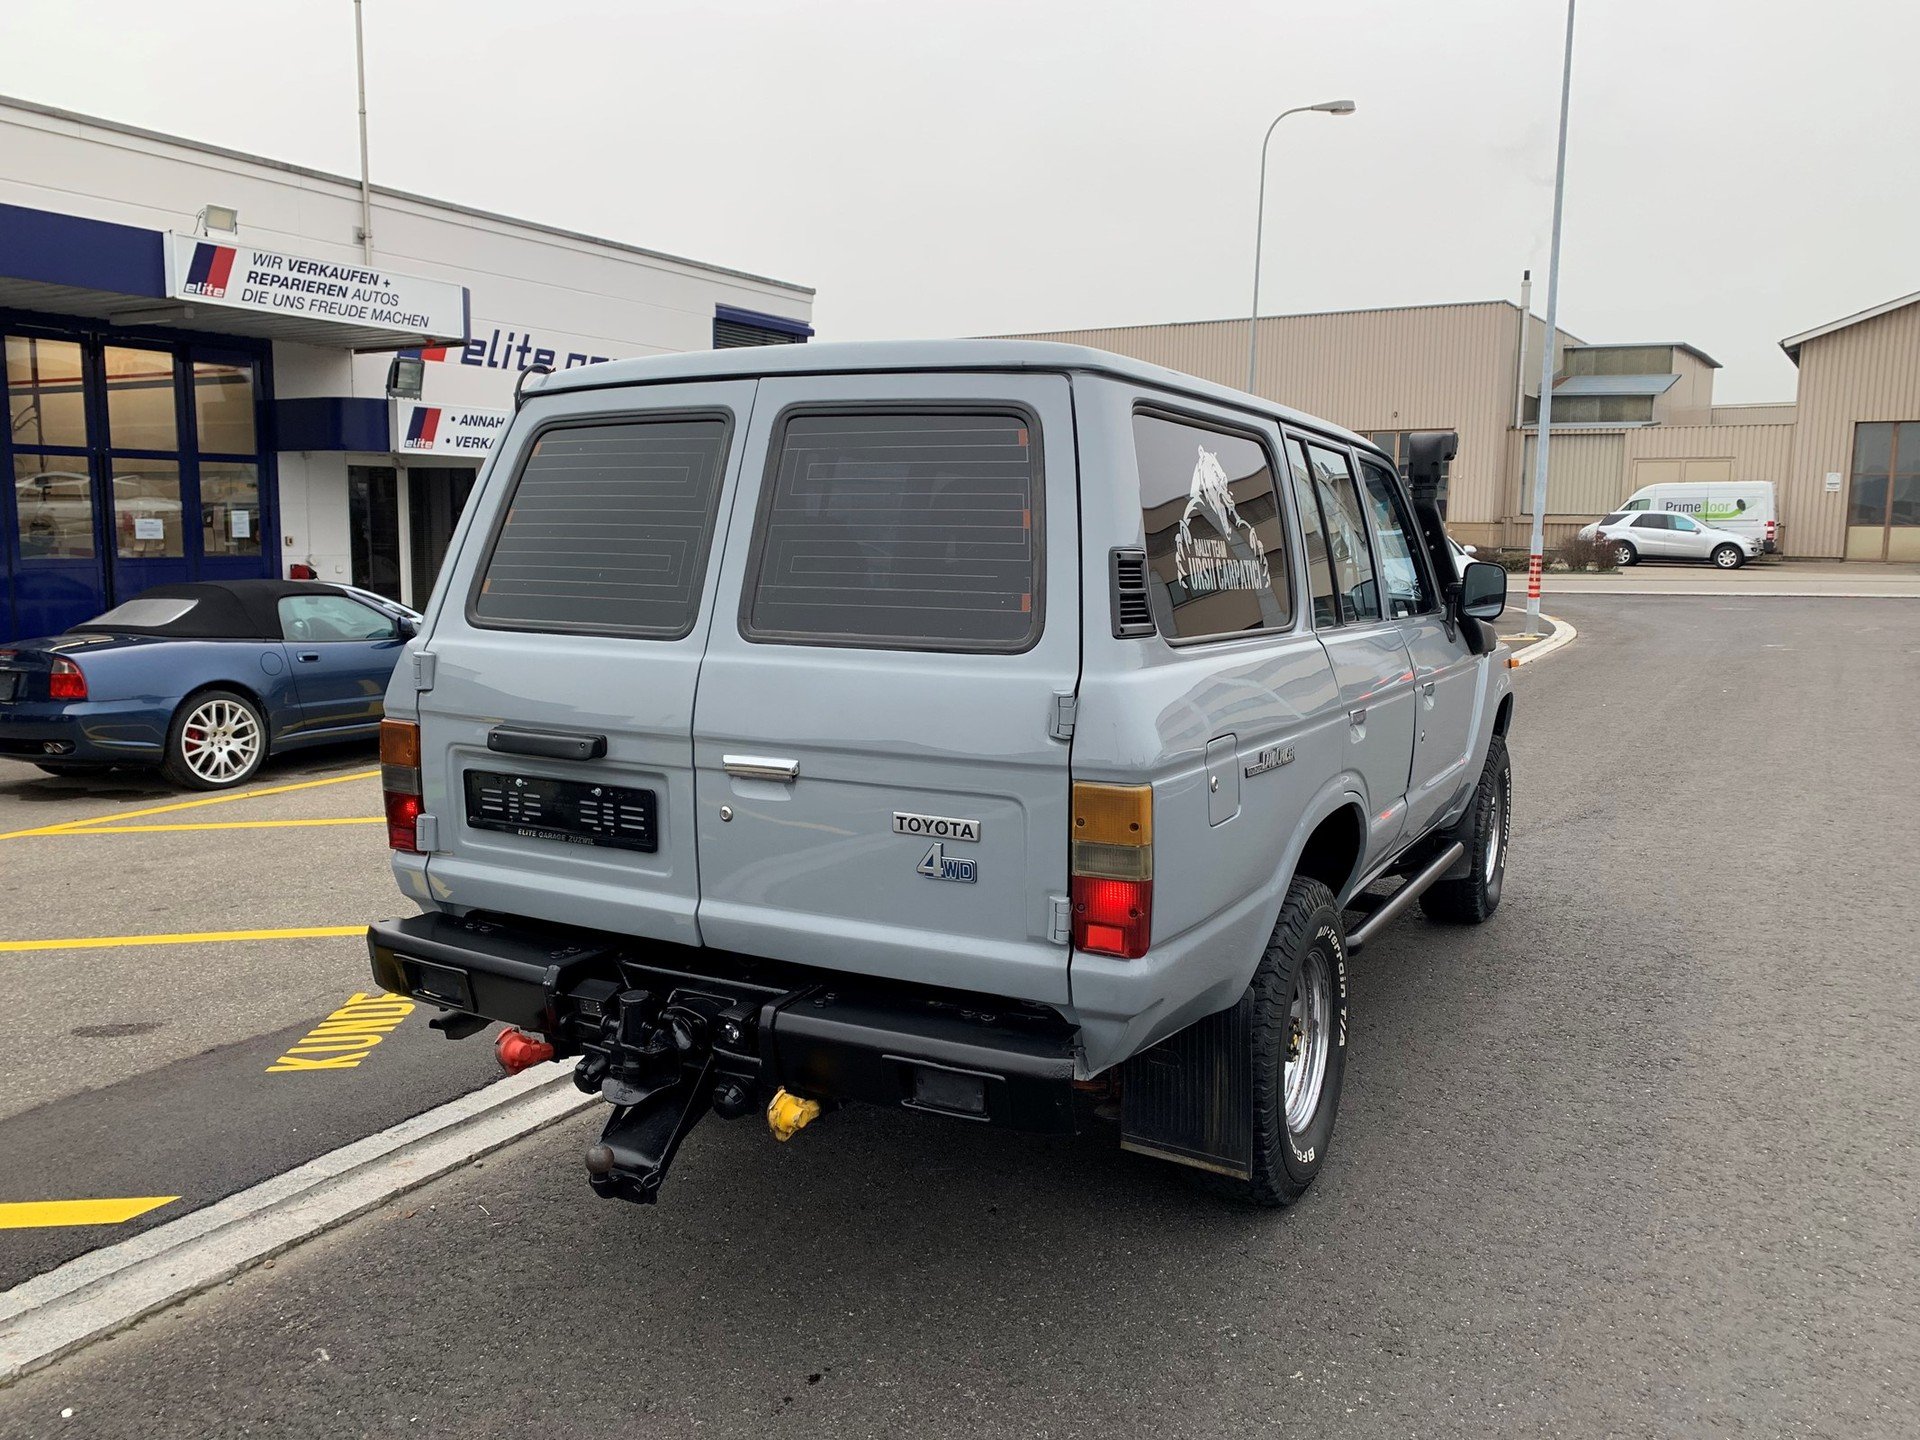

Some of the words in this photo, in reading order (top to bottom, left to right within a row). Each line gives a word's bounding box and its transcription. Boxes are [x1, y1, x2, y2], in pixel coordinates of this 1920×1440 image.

[253, 252, 283, 270] WIR
[288, 259, 379, 286] VERKAUFEN
[184, 281, 225, 298] elite
[246, 270, 348, 298] REPARIEREN
[351, 288, 399, 307] AUTOS
[241, 288, 269, 305] DIE
[272, 293, 305, 311] UNS
[308, 298, 368, 319] FREUDE
[370, 308, 430, 328] MACHEN
[460, 329, 556, 375] elite
[404, 437, 434, 450] elite
[517, 828, 538, 838] ELITE
[538, 830, 567, 842] GARAGE
[896, 816, 975, 839] TOYOTA
[917, 842, 977, 884] 4WD
